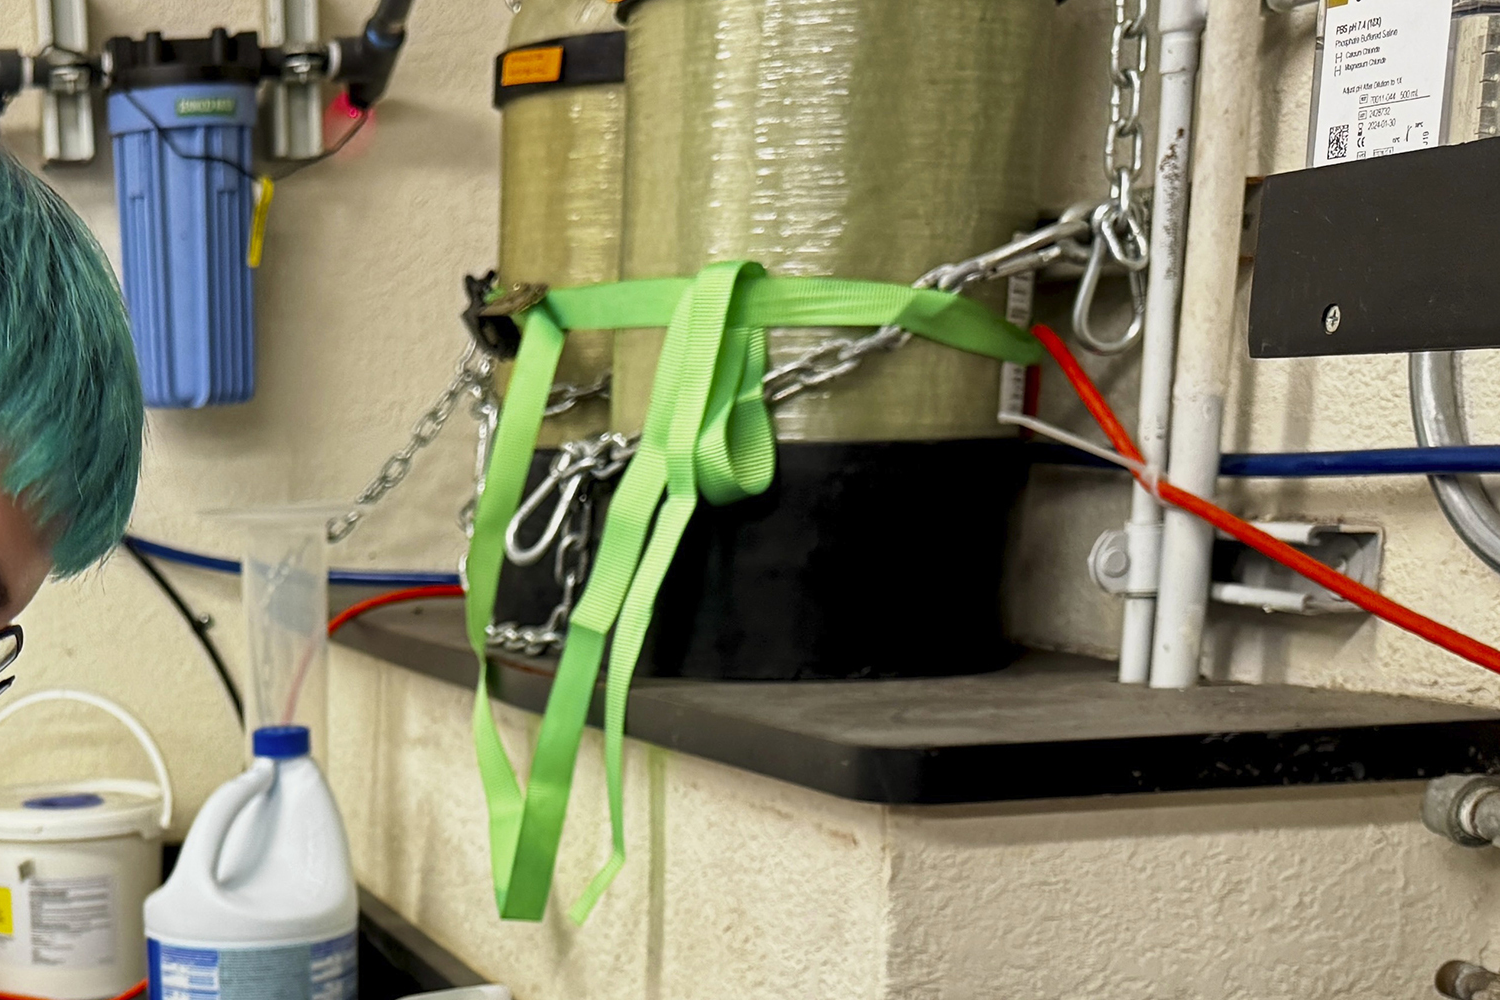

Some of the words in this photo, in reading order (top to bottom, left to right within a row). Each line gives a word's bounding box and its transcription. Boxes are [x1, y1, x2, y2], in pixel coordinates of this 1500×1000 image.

[1336, 24, 1348, 36] PBS
[1348, 22, 1357, 35] pH
[1335, 37, 1360, 48] Phosphate
[1360, 31, 1382, 43] Buffered
[1382, 28, 1398, 39] Saline
[1345, 50, 1362, 59] Calcium
[1362, 46, 1381, 56] Chloride
[1344, 61, 1369, 71] Magnesium
[1369, 57, 1387, 67] Chloride
[1342, 86, 1356, 95] Adjust
[1363, 82, 1373, 91] After
[1373, 79, 1390, 90] Dilution
[1400, 90, 1411, 100] 500
